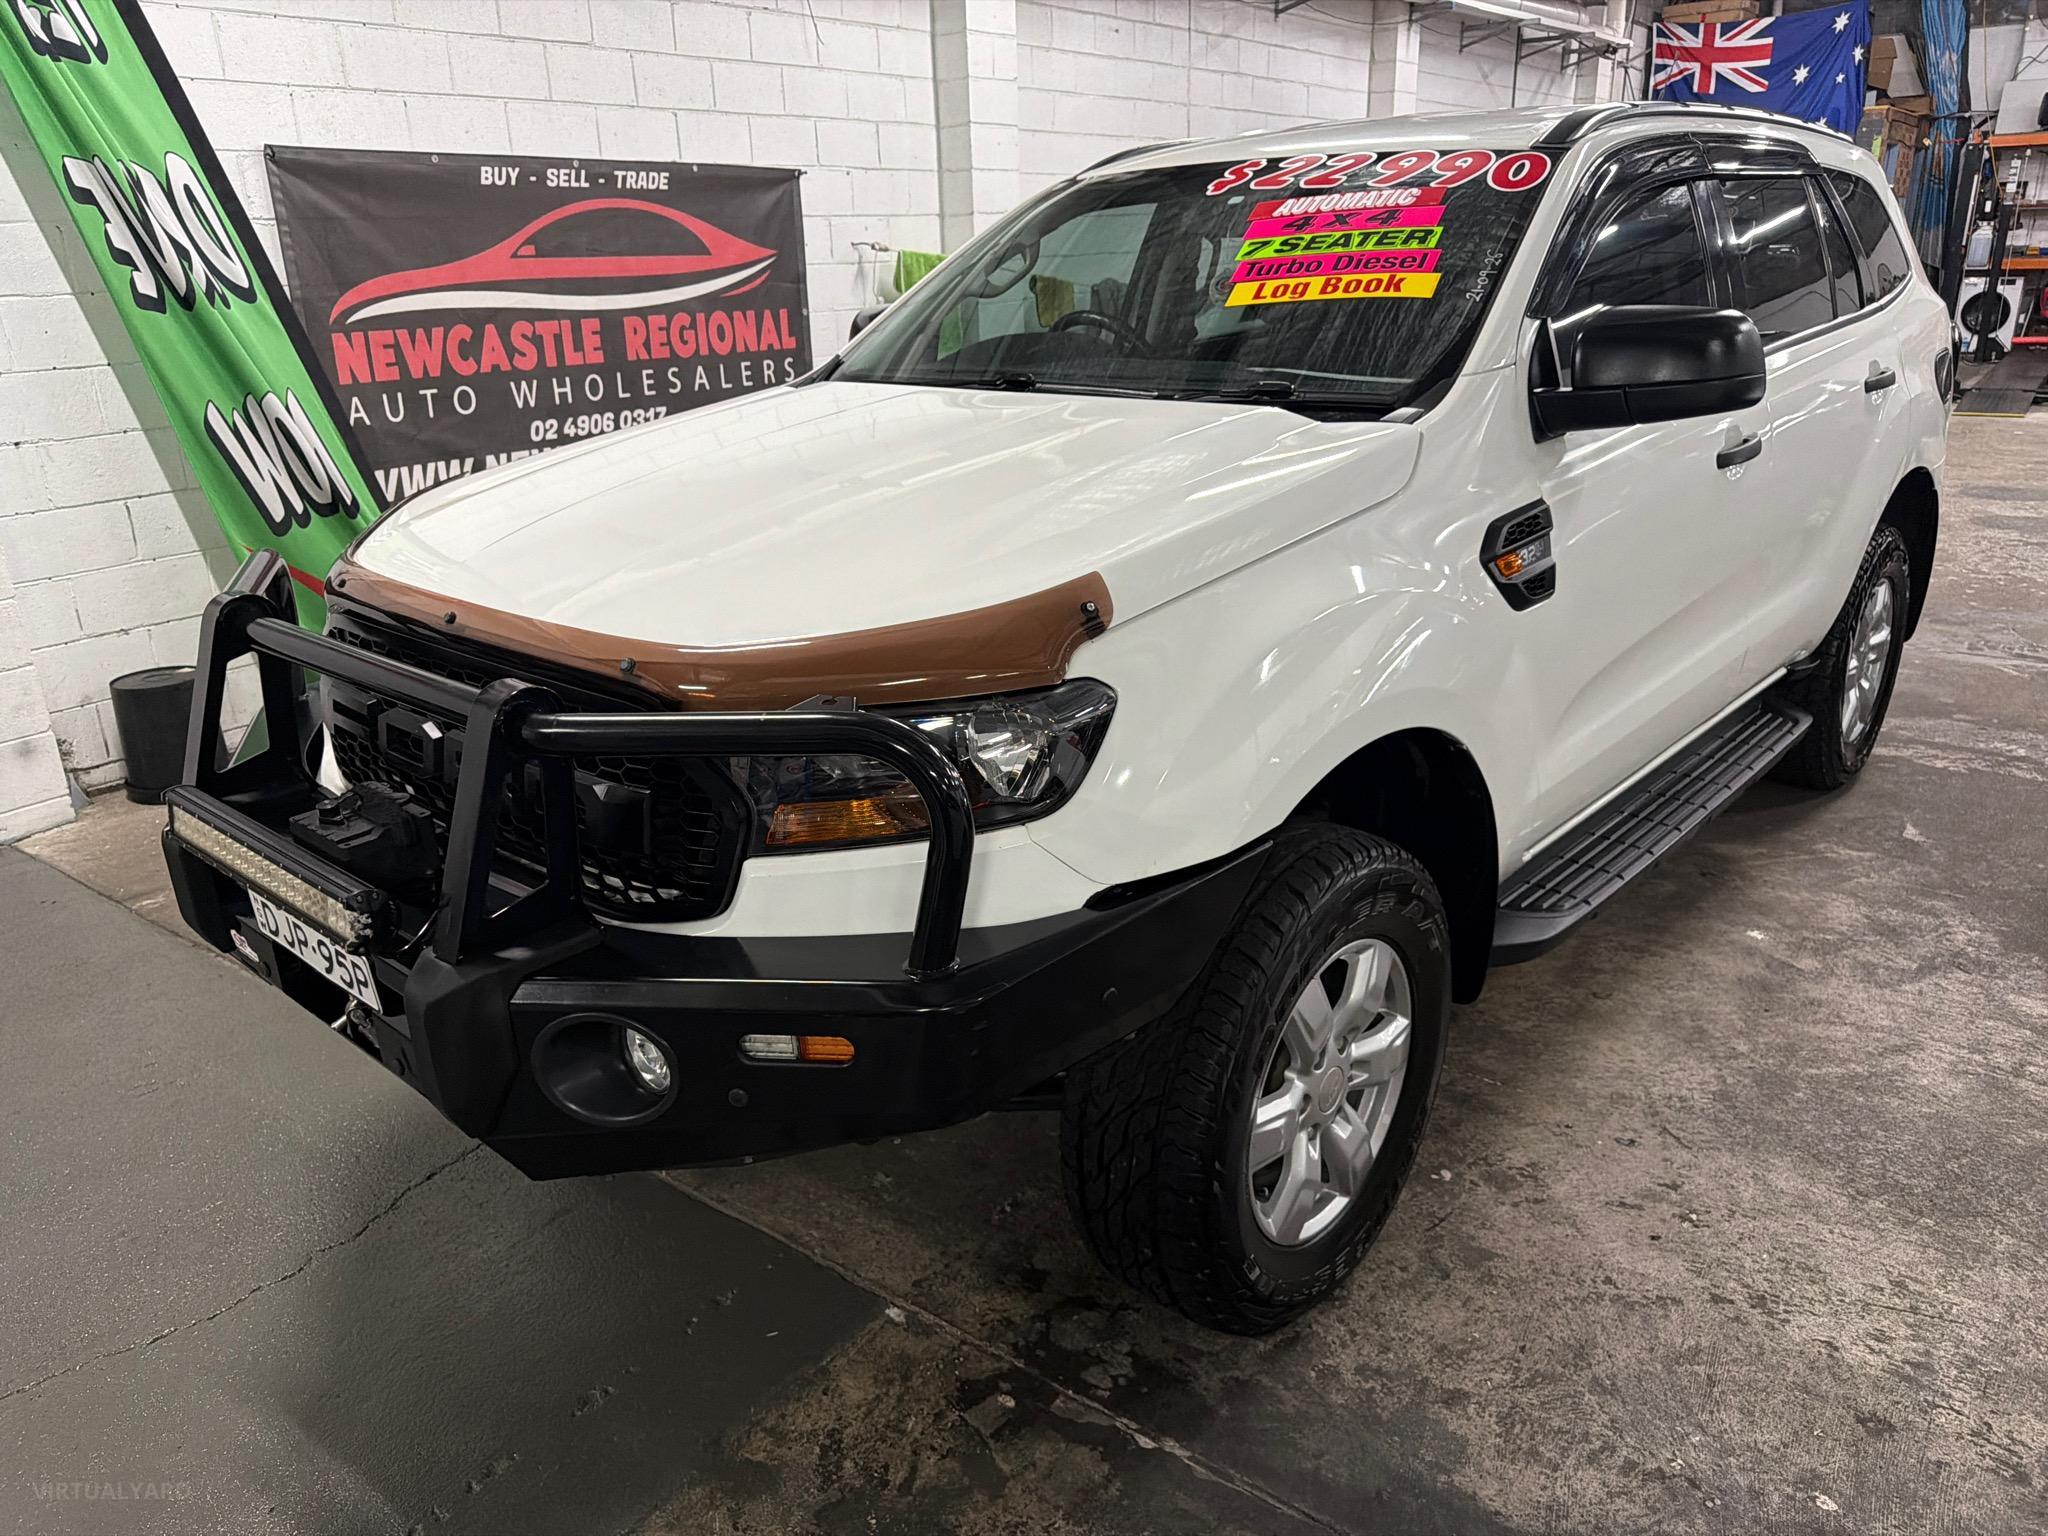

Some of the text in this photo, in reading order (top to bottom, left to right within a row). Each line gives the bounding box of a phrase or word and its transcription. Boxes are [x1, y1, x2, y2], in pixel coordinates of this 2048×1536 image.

[480, 166, 520, 186] BUY
[546, 168, 590, 188] SELL
[614, 170, 670, 190] TRADE
[1206, 150, 1551, 196] $22990
[1272, 188, 1421, 217] AUTOMATIC
[1244, 253, 1429, 277] Turbo Diesel
[1252, 275, 1407, 300] Log Book
[331, 308, 796, 385] NEWCASTLE REGIONAL
[350, 357, 796, 427] AUTO WHOLESALERS
[530, 419, 558, 441] 02
[563, 412, 615, 437] 4906
